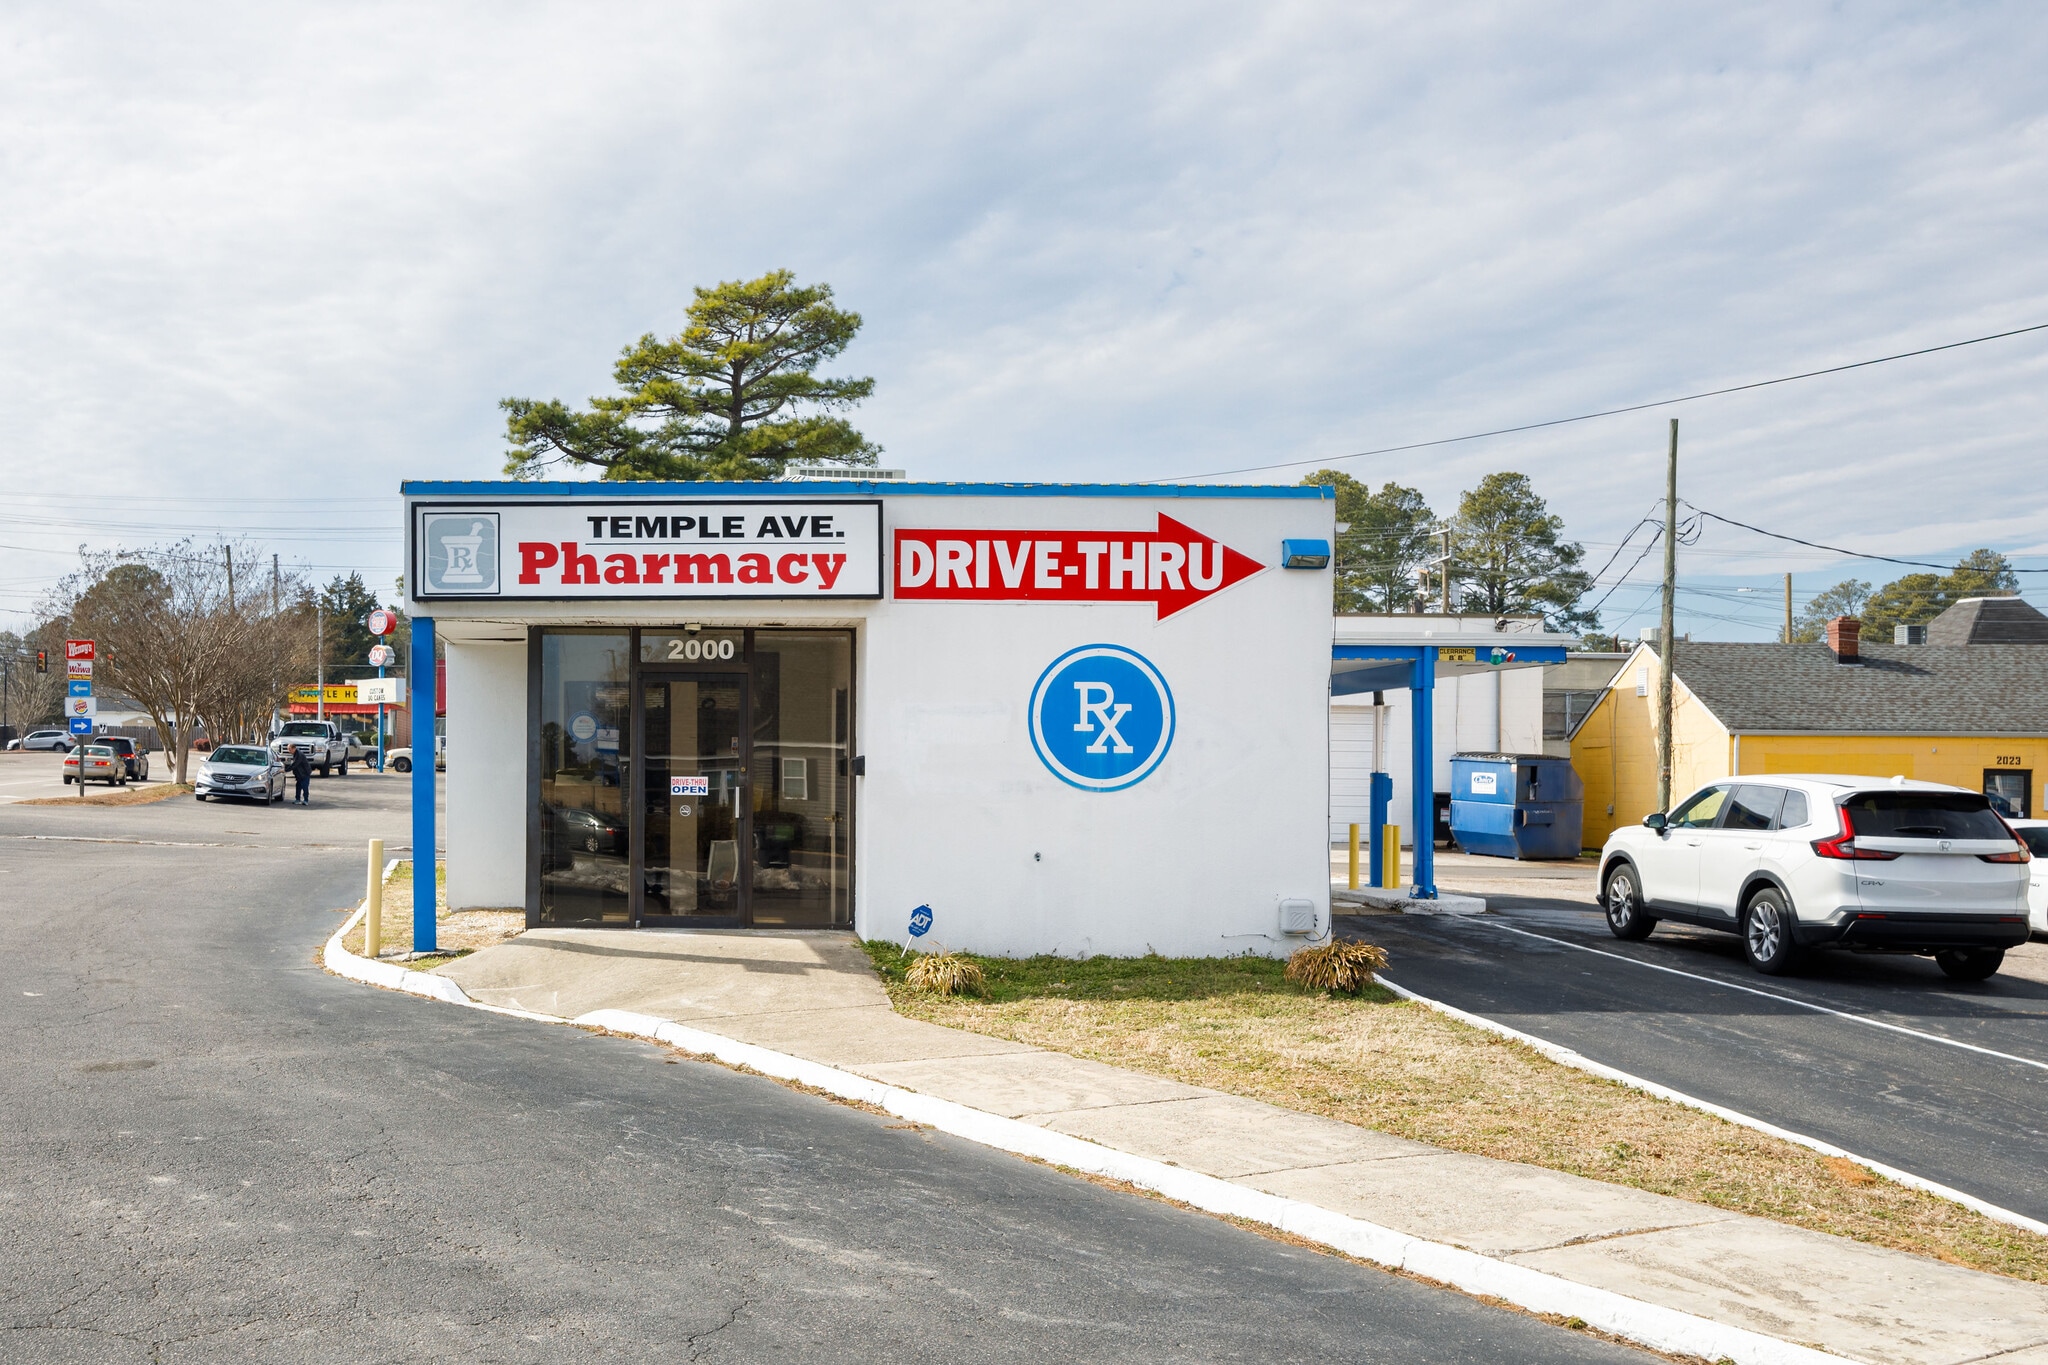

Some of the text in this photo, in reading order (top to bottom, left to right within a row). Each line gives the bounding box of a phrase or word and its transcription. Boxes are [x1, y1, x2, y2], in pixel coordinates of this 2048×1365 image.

[587, 516, 845, 539] TEMPLE AVE.
[518, 542, 847, 590] Pharmacy
[899, 540, 1224, 590] DRIVE-THRU
[68, 643, 92, 656] Wendy's
[668, 639, 735, 660] 2000
[1996, 756, 2021, 765] 2023
[672, 778, 707, 786] DRIVE-THRU
[910, 913, 931, 928] ADT
